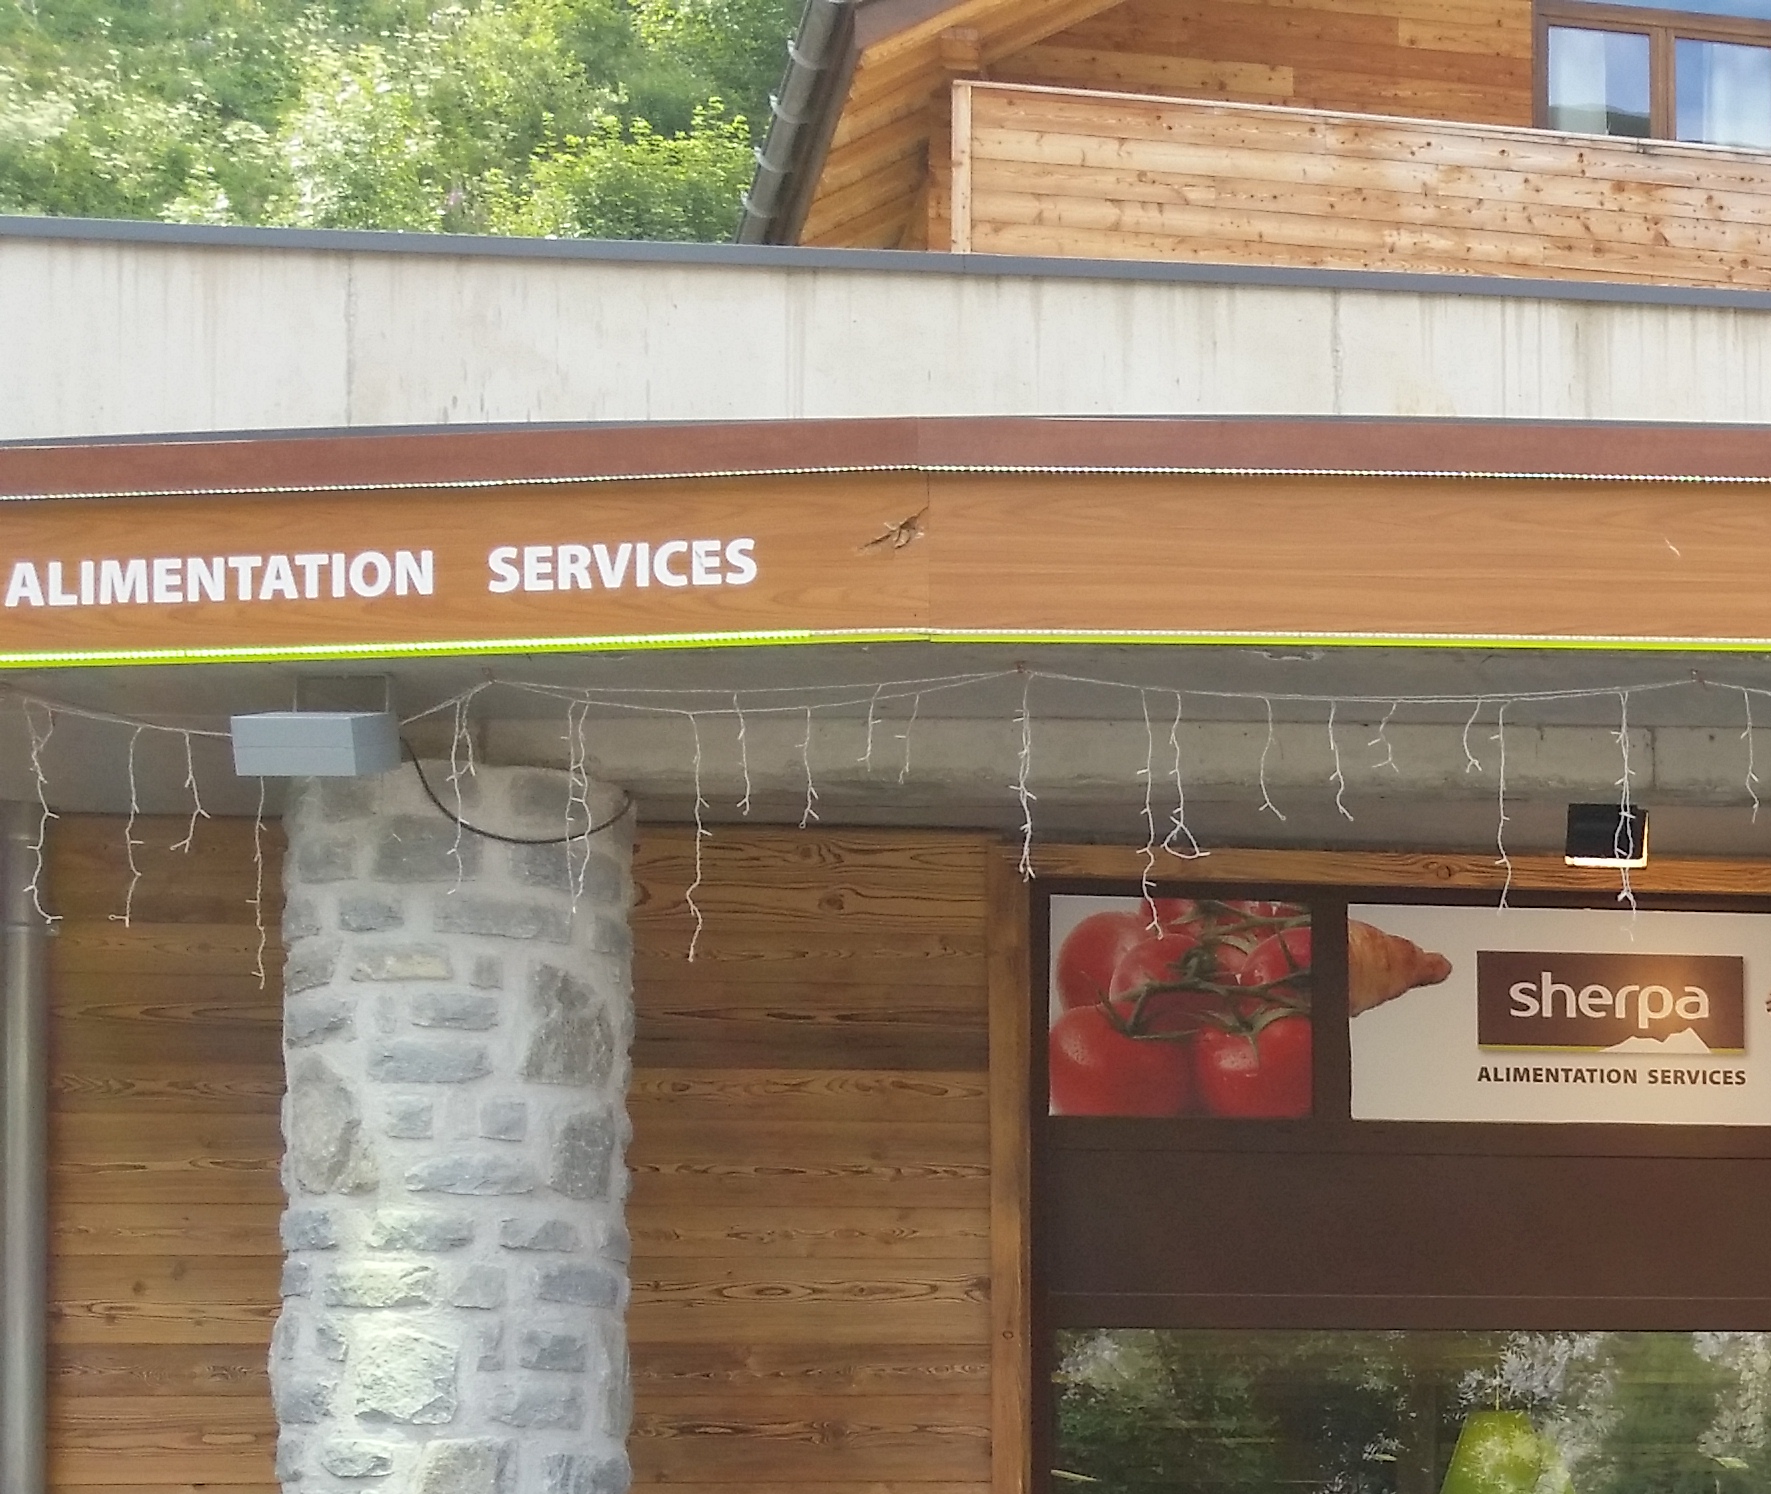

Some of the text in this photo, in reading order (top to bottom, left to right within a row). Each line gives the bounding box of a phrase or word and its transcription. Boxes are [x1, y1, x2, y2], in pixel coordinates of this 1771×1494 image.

[6, 538, 758, 607] ALIMENTATION SERVICES
[1508, 971, 1710, 1029] sherpa
[1477, 1066, 1747, 1086] ALIMENTATION SERVICES
